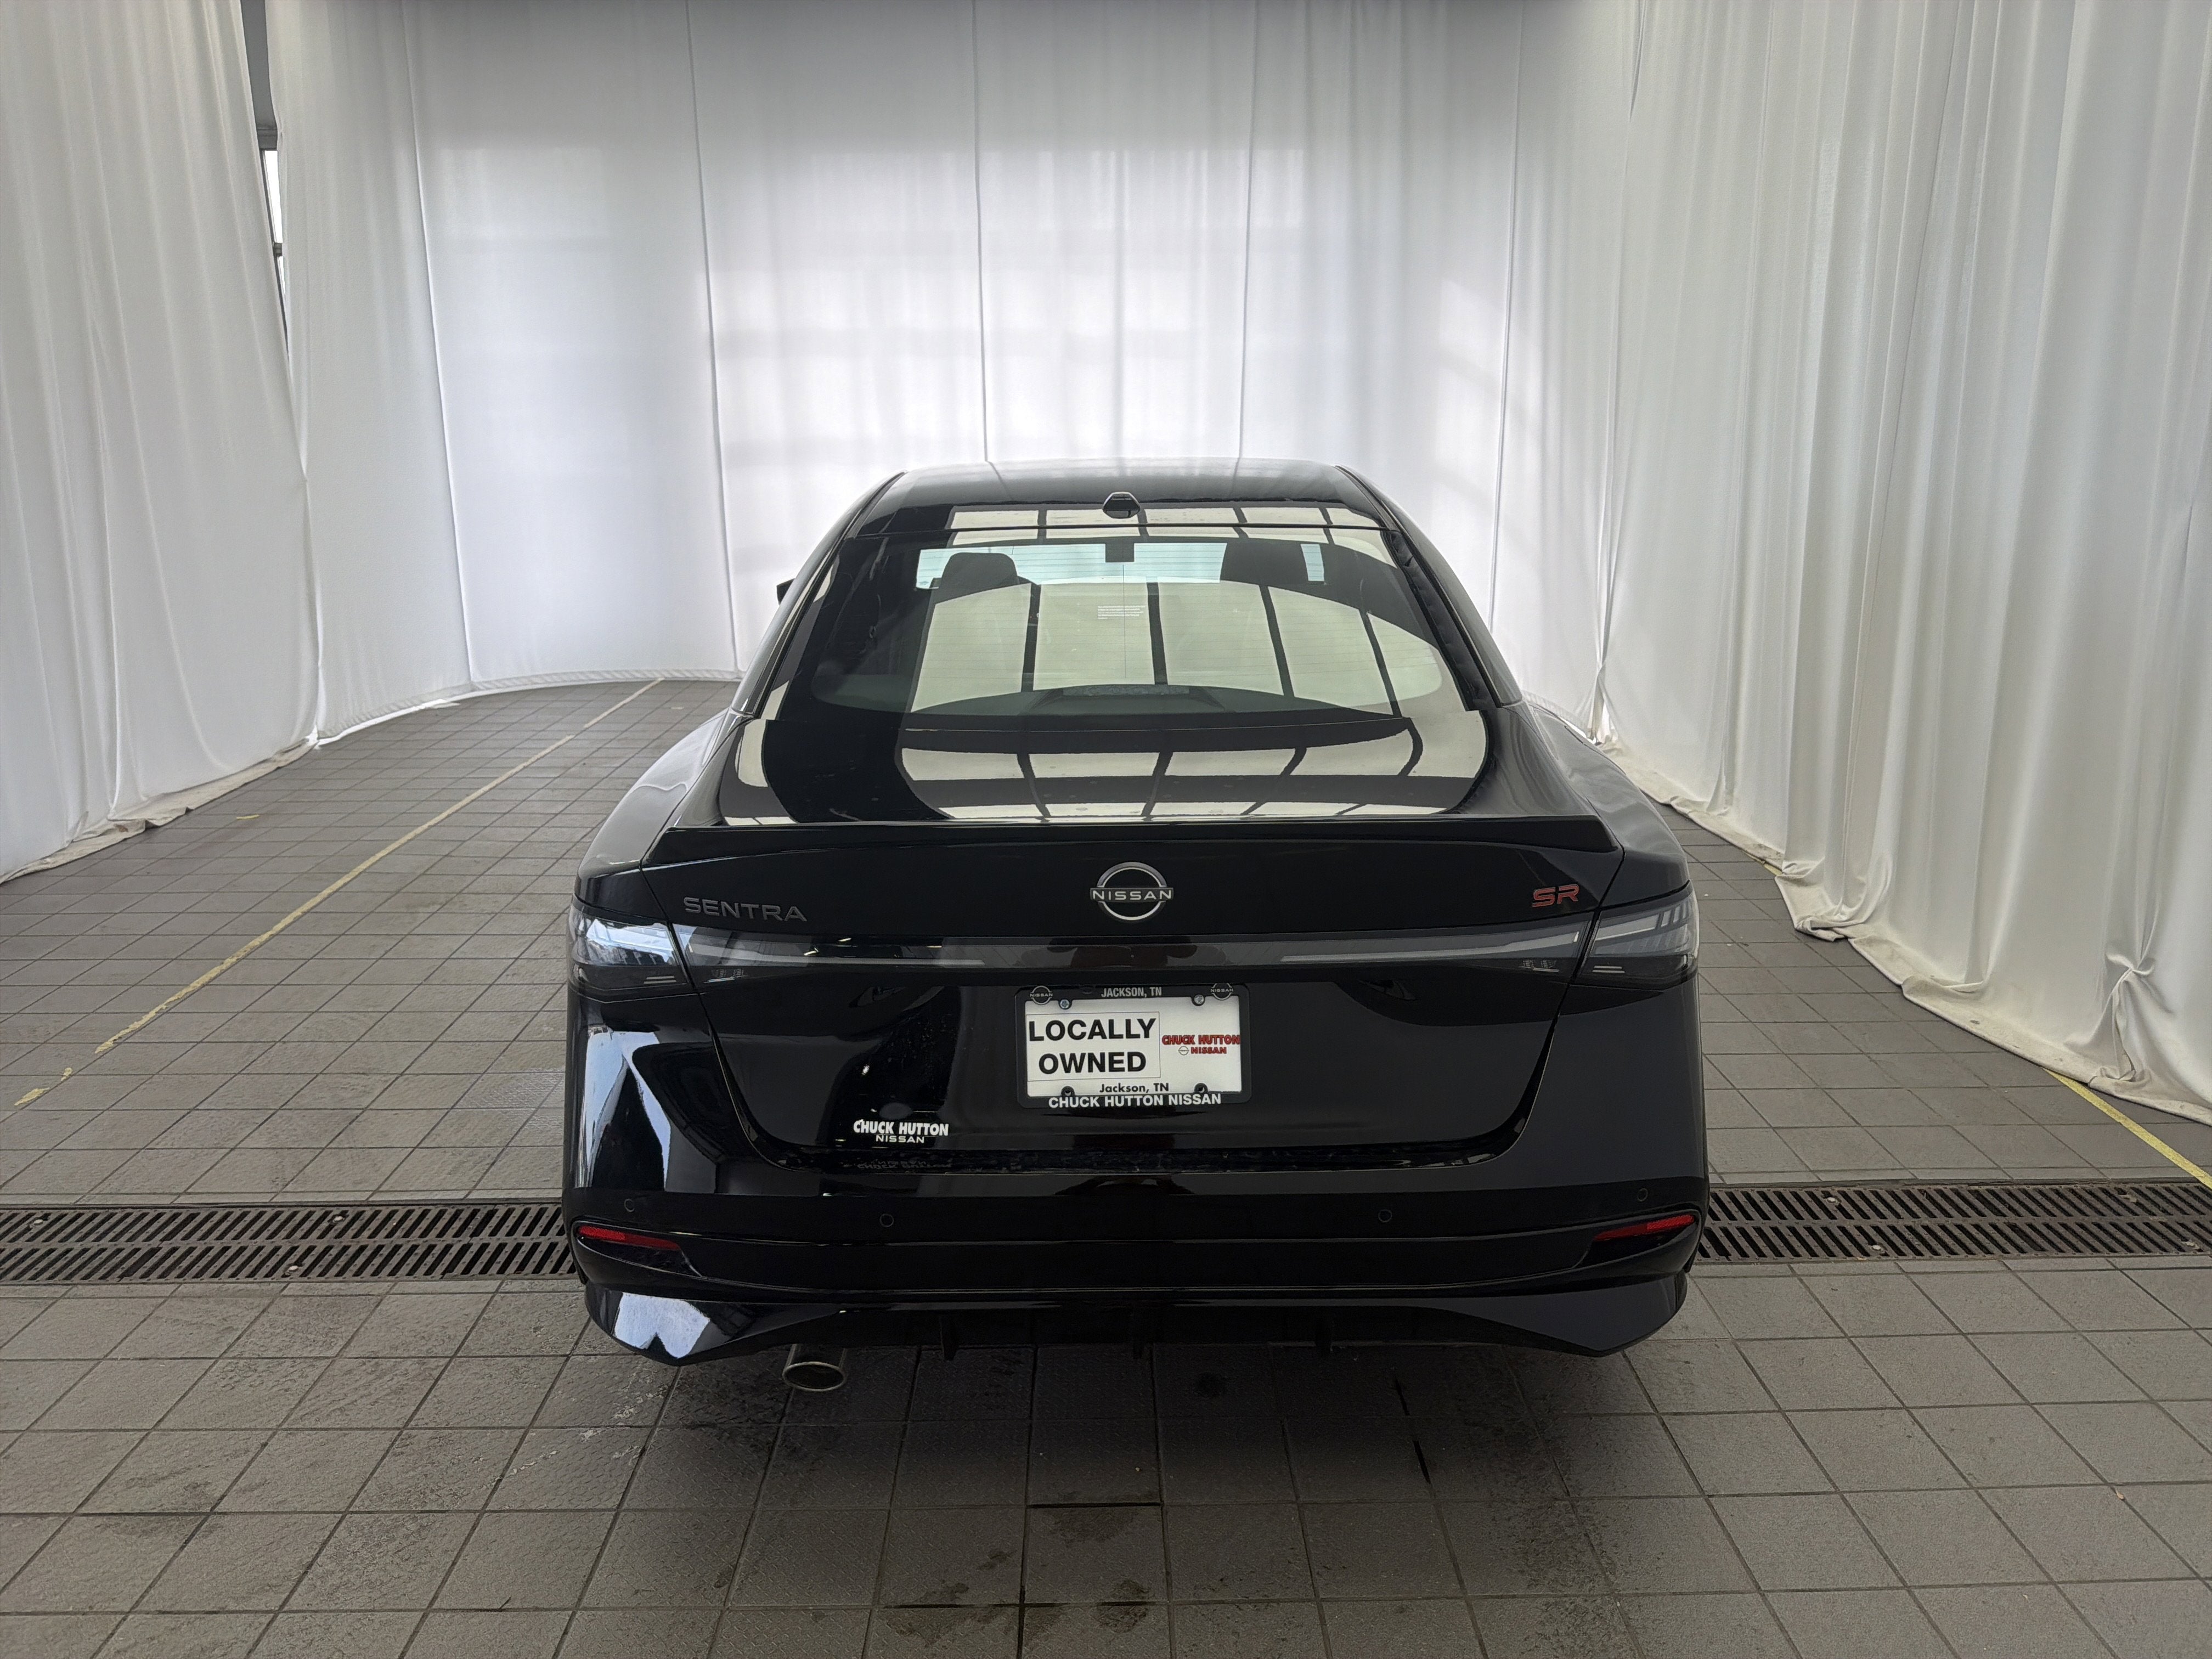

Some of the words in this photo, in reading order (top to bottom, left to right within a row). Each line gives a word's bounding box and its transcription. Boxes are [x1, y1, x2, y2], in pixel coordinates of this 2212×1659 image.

[1092, 890, 1172, 900] NISSAN
[1531, 883, 1580, 907] SR
[684, 896, 808, 922] SENTRA
[1101, 987, 1147, 998] JACKSON,
[1150, 986, 1162, 996] TN
[1029, 1018, 1156, 1041] LOCALLY
[1162, 1035, 1195, 1045] CHUCK
[1198, 1035, 1240, 1045] HUTTON
[1039, 1051, 1147, 1075] OWNED
[1099, 1082, 1149, 1093] Jackson,
[1153, 1082, 1169, 1092] TN
[1048, 1096, 1100, 1108] CHUCK
[1104, 1094, 1164, 1107] HUTTON
[1169, 1093, 1221, 1105] NISSAN
[853, 1119, 894, 1133] CHUCK
[899, 1122, 949, 1136] HUTTON
[876, 1135, 924, 1143] NISSAN
